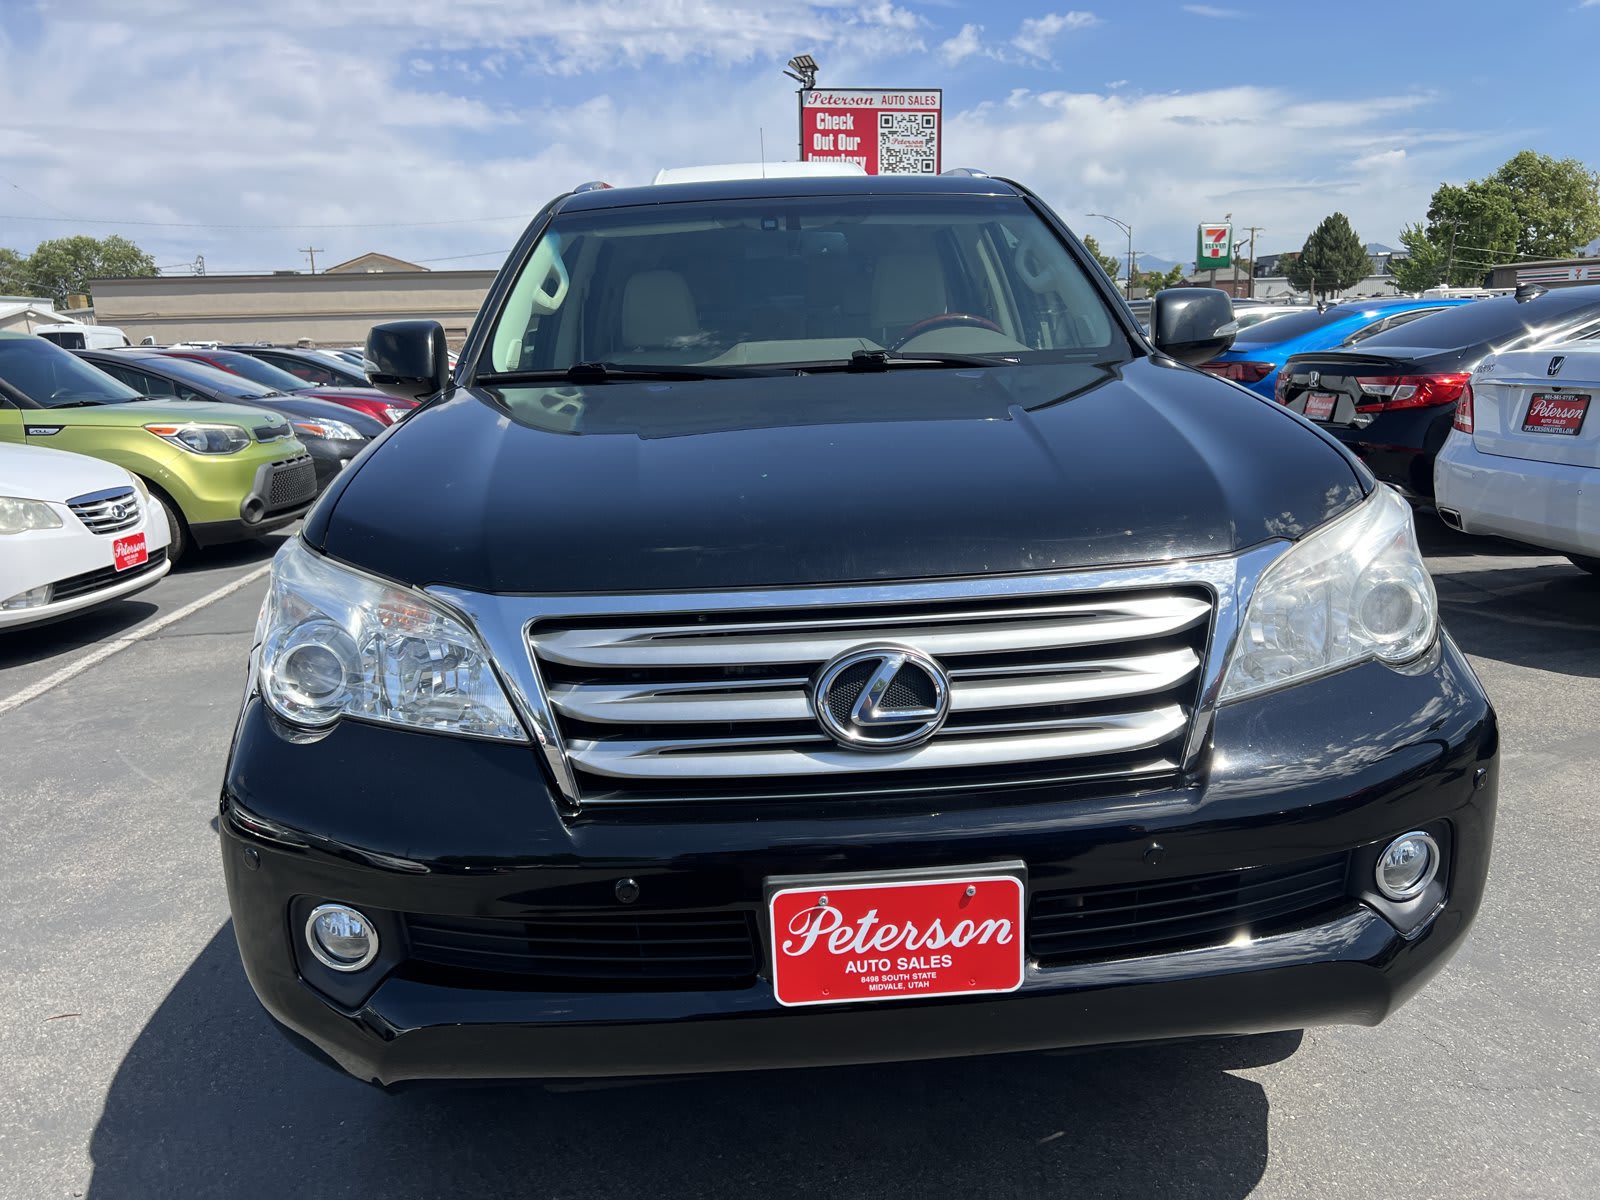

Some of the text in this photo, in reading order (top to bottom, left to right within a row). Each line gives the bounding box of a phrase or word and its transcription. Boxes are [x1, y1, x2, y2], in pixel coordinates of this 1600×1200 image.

[808, 91, 936, 106] Peterson AUTO SALES
[816, 112, 855, 130] Check
[813, 133, 861, 151] Out Our
[1530, 400, 1584, 419] Peterson
[115, 542, 146, 558] Peterson
[782, 905, 1013, 956] Peterson
[845, 954, 952, 974] AUTO SALES
[860, 971, 937, 983] 8498 SOUTH STATE
[869, 981, 930, 991] MIDVALE, UTAH
